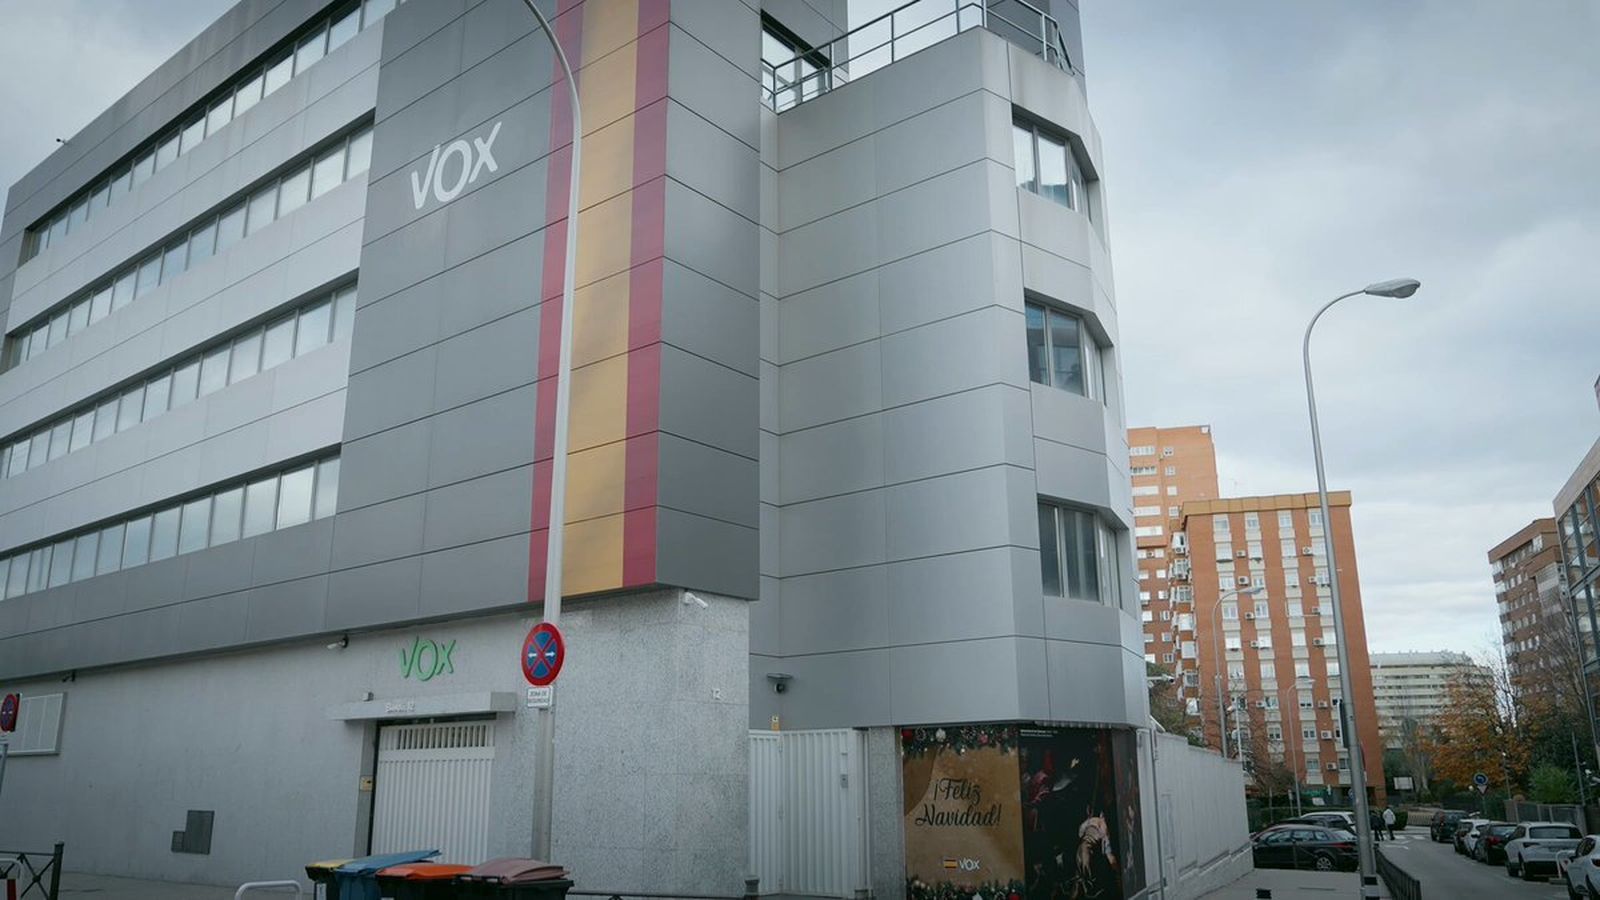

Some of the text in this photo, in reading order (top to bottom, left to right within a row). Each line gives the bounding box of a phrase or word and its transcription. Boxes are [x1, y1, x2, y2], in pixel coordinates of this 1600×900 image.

[411, 121, 502, 210] VOX
[400, 635, 456, 681] VOX
[933, 778, 981, 806] ¡Feliz
[915, 803, 1002, 827] Navidad!
[959, 857, 980, 871] VOX
